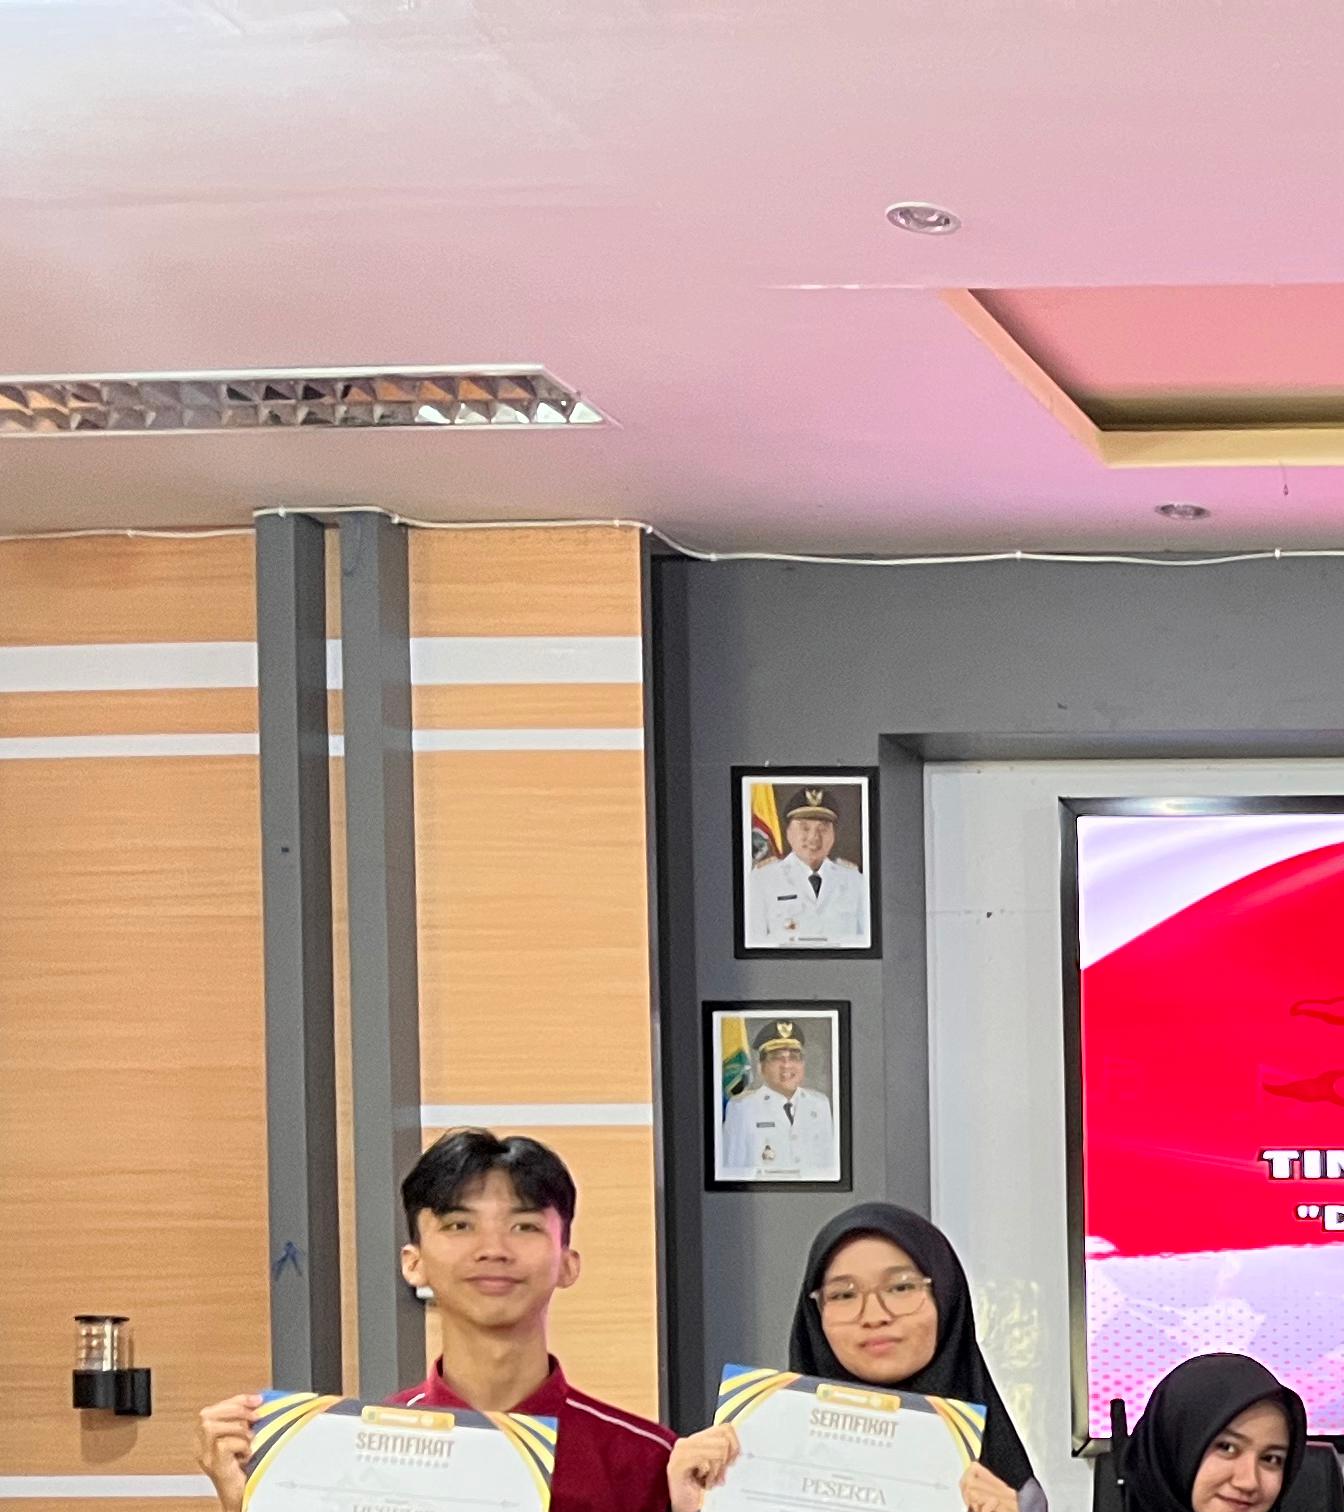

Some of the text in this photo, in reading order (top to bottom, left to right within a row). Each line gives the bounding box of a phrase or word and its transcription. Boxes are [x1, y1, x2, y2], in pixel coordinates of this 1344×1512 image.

[810, 1408, 899, 1439] SERTIFIKAT
[355, 1431, 455, 1458] SERTIFIKAT
[801, 1477, 887, 1505] PESERTA
